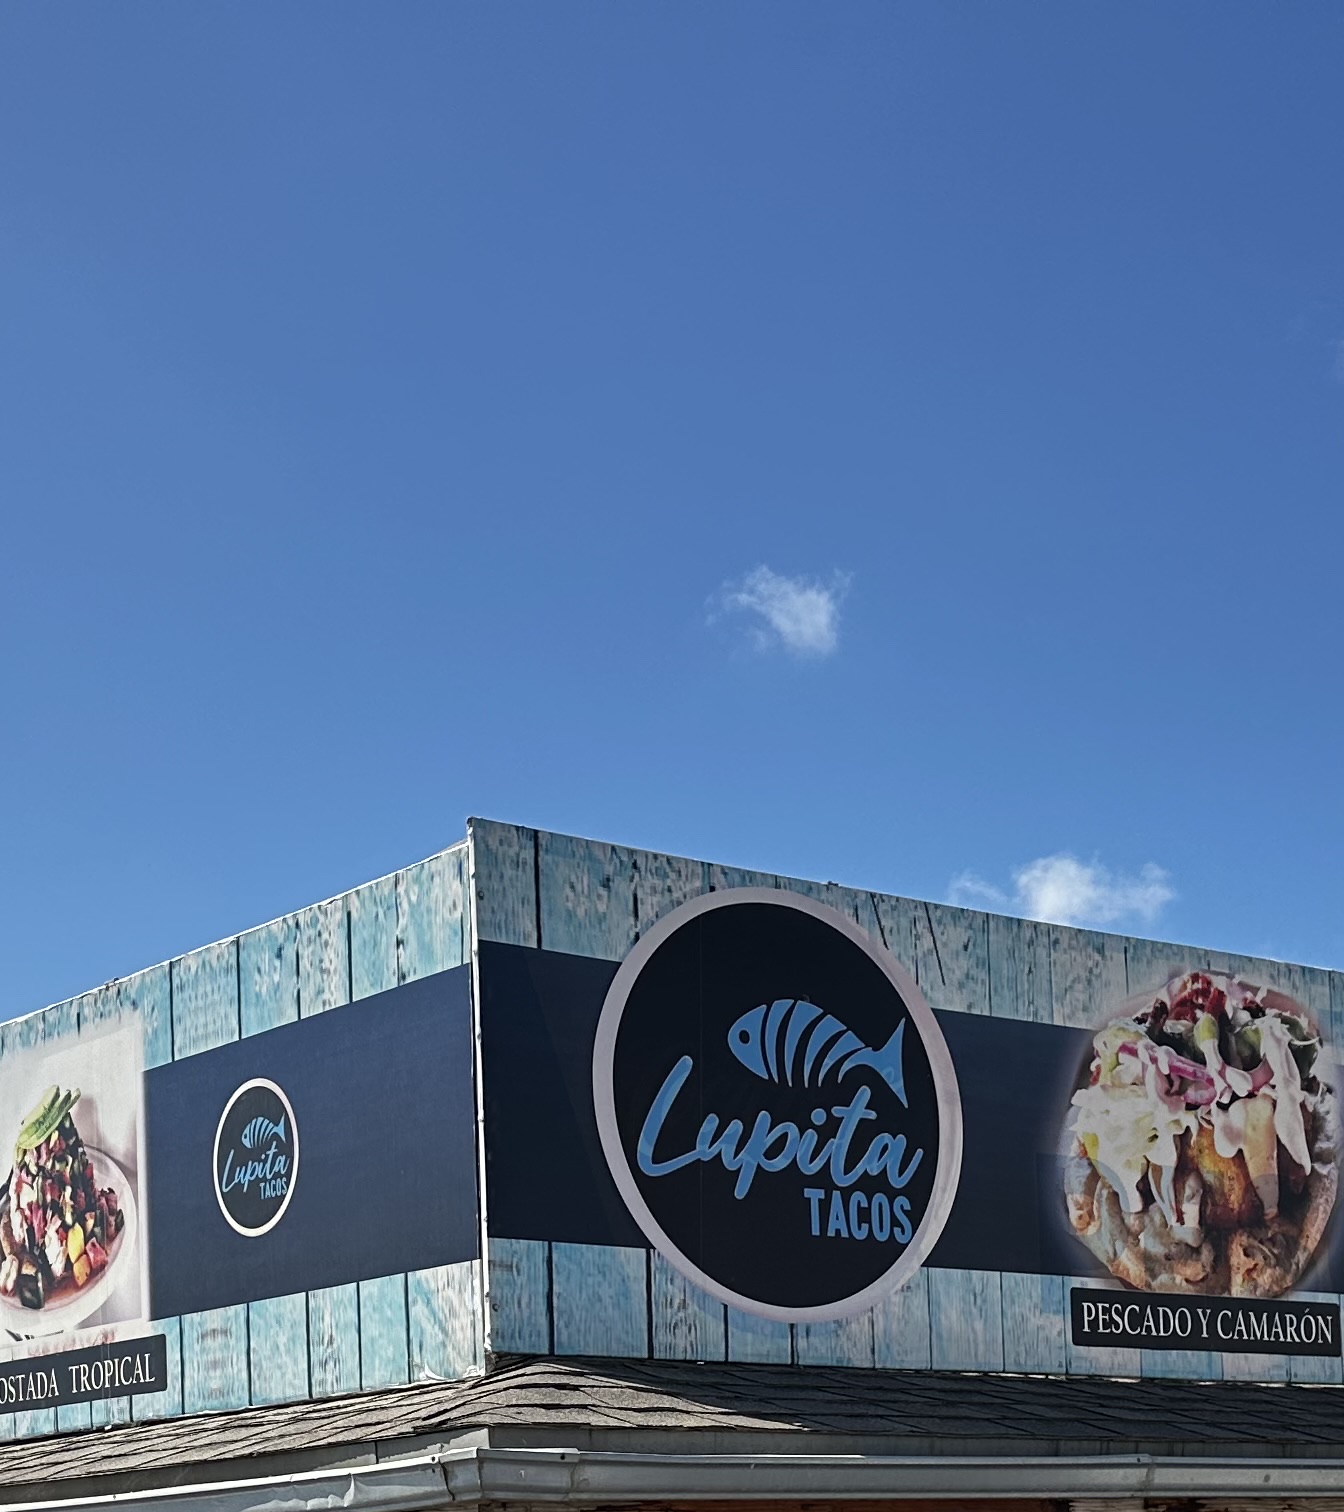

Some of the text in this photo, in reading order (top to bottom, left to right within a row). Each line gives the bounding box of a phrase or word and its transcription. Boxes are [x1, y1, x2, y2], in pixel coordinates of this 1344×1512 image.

[637, 1055, 924, 1200] Lupita
[222, 1141, 290, 1193] Lupita
[259, 1178, 287, 1200] TACOS
[804, 1186, 914, 1245] TACOS
[1082, 1302, 1333, 1344] PESCADO Y CAMARÓN
[68, 1353, 156, 1394] TROPICAL
